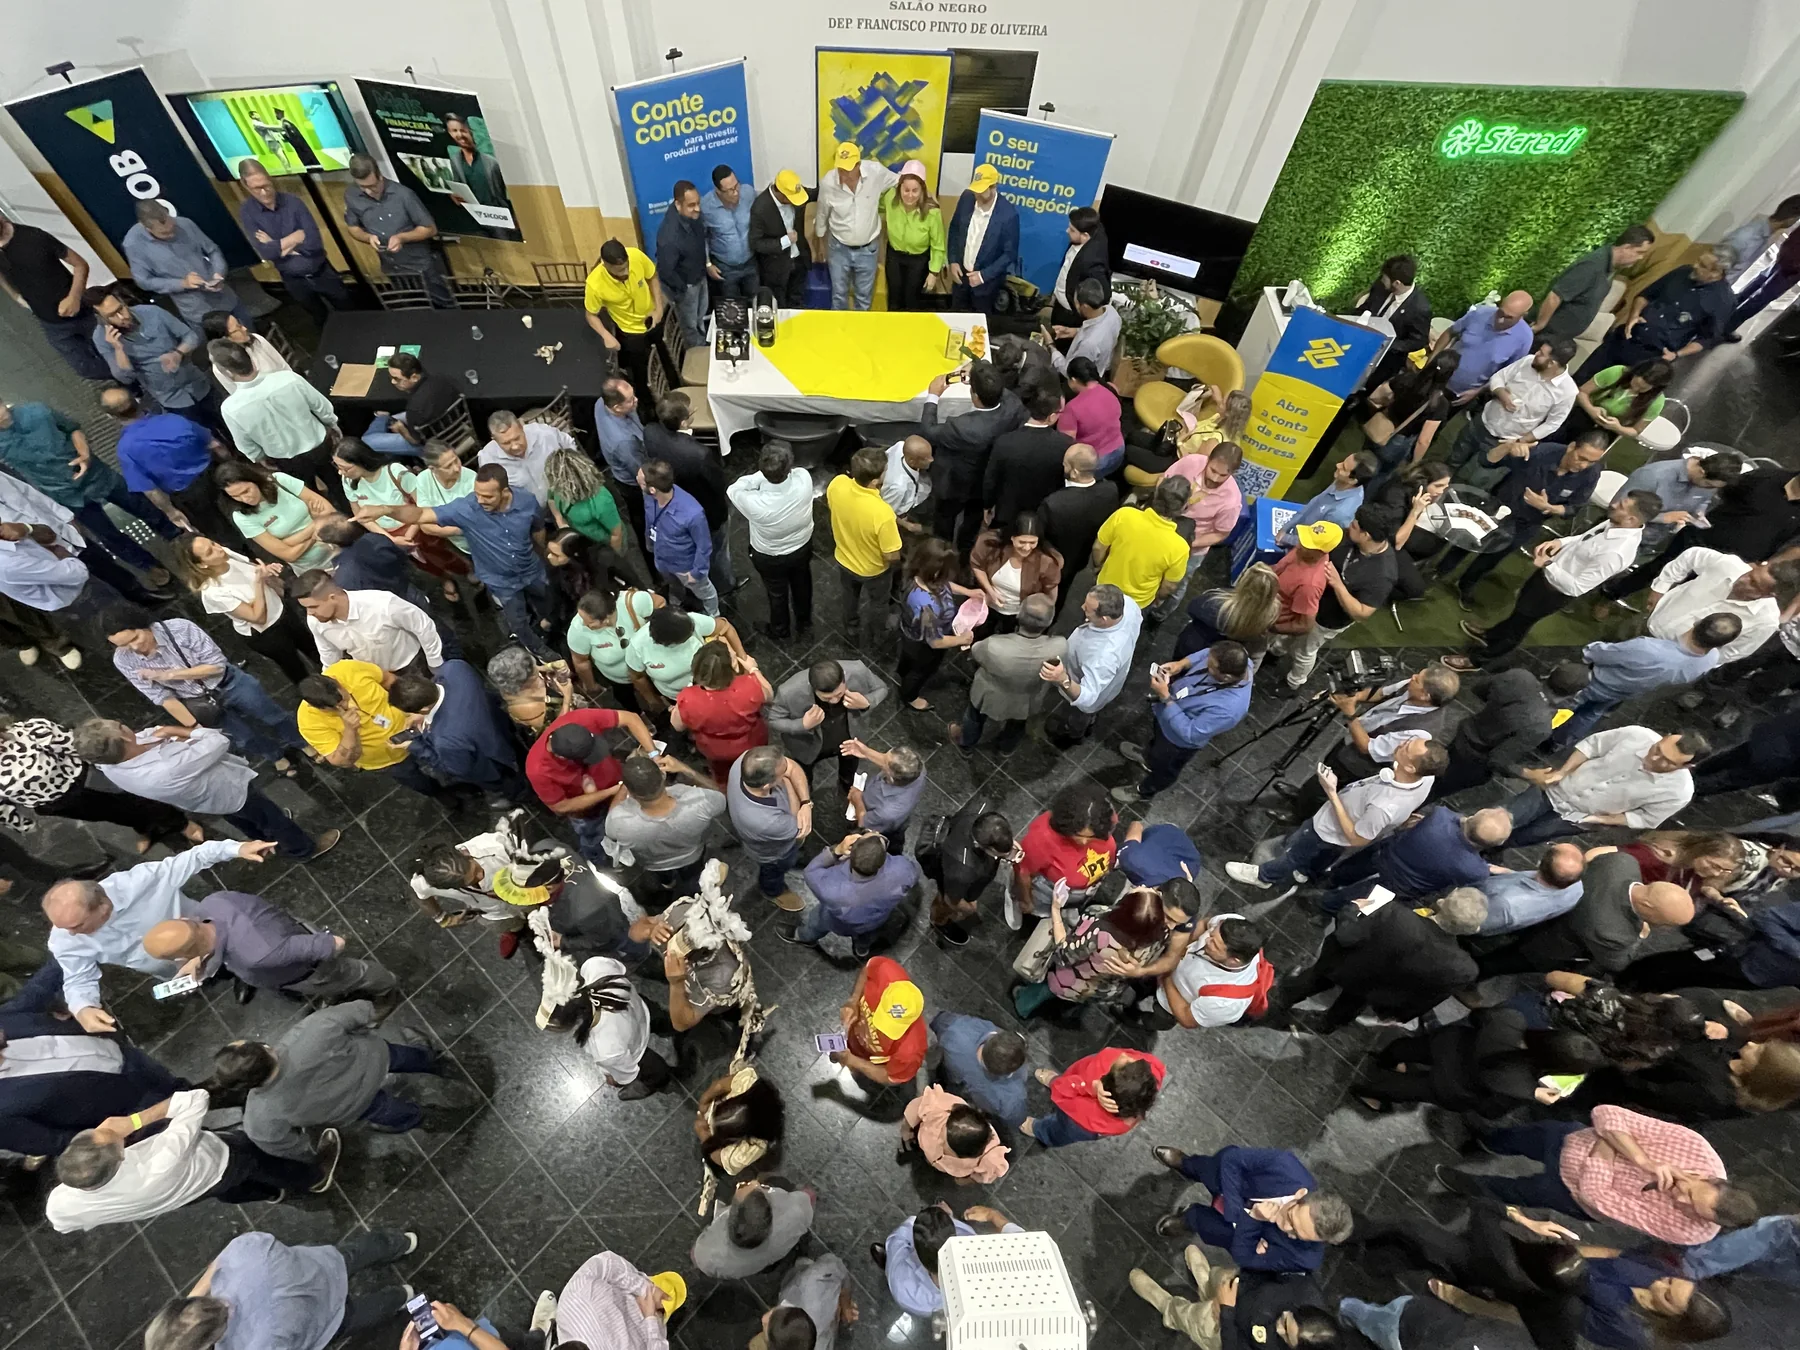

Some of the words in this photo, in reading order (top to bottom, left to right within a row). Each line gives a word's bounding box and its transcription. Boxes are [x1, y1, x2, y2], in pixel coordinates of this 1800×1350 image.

[889, 0, 934, 12] SALÃO
[938, 3, 987, 14] NEGRO
[857, 18, 926, 32] FRANCISCO
[929, 21, 967, 34] PINTO
[970, 22, 987, 35] DE
[990, 23, 1048, 36] OLIVEIRA
[631, 92, 704, 125] Conte
[635, 106, 737, 145] conosco
[664, 145, 700, 162] produzir
[708, 136, 739, 149] crescer
[684, 135, 704, 147] para
[989, 130, 1004, 146] O
[1006, 137, 1039, 154] seu
[1475, 125, 1588, 154] Sicredi
[985, 152, 1035, 171] maior
[1053, 184, 1076, 198] no
[1276, 399, 1310, 417] Abra
[1261, 409, 1269, 418] a
[1271, 414, 1309, 432] conta
[1257, 425, 1272, 437] da
[1274, 433, 1298, 445] sua
[1242, 434, 1297, 460] empresa.
[1087, 857, 1105, 877] PT
